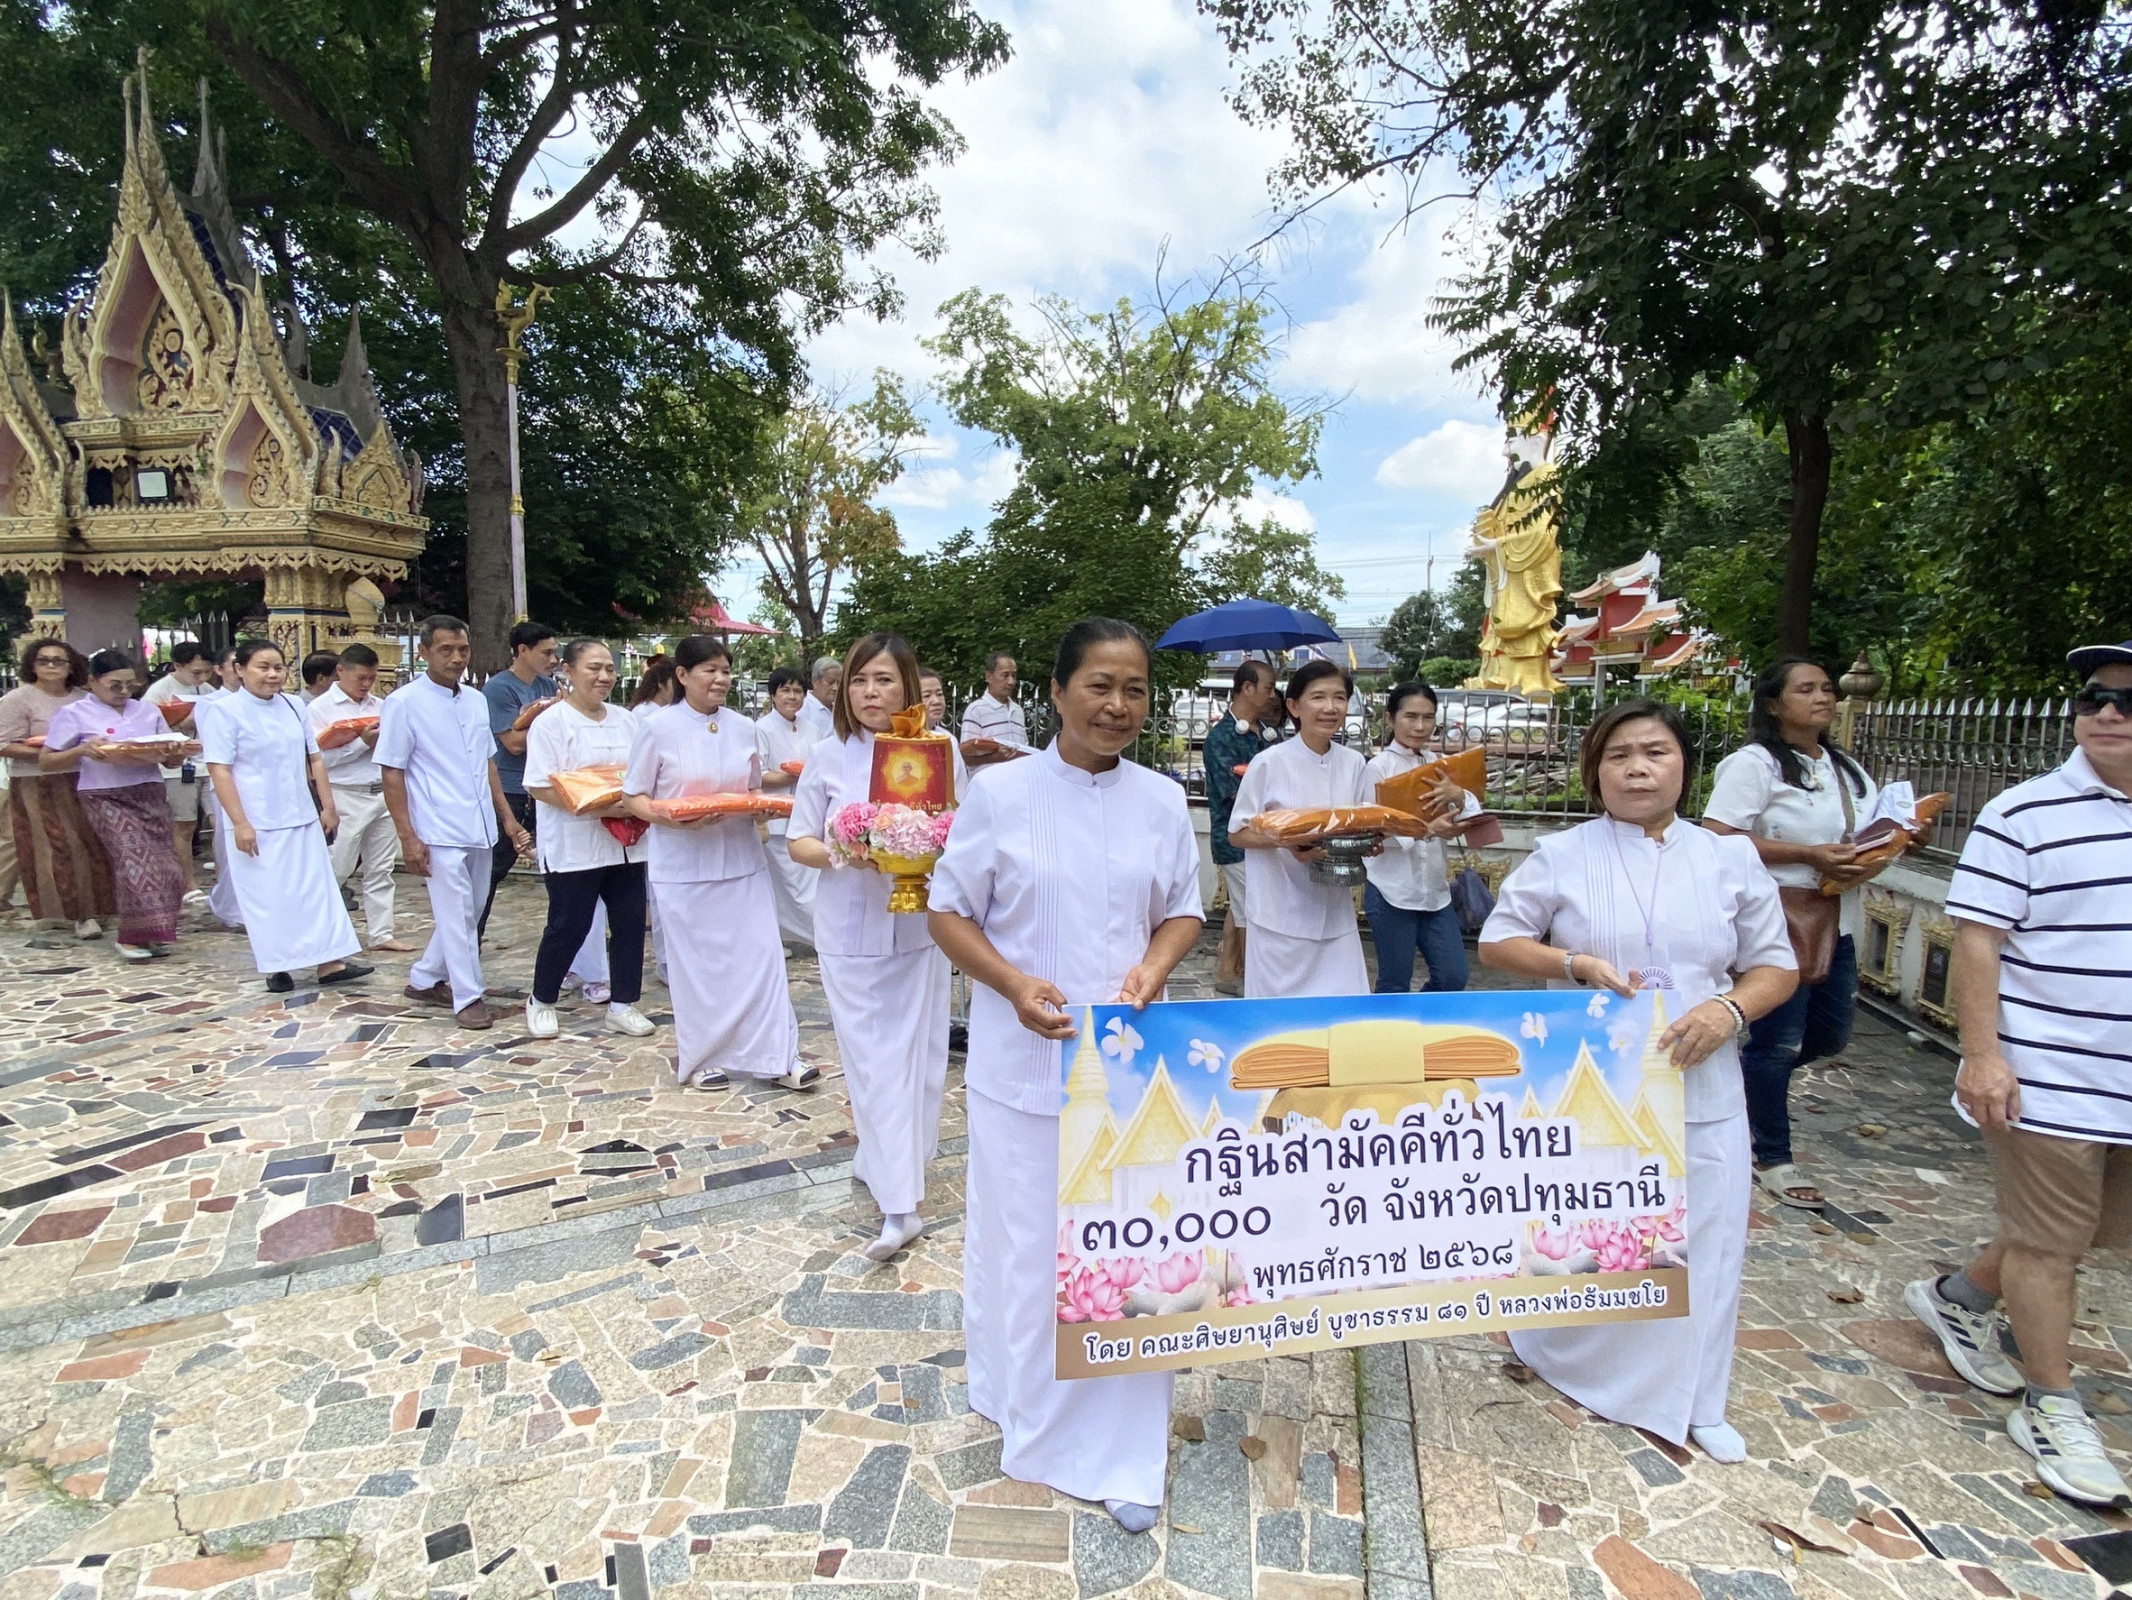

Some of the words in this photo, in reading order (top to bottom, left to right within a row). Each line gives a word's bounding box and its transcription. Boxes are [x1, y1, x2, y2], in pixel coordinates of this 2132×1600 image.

[1185, 1099, 1572, 1197] กฐินสามัคคีทั่วไทย
[1083, 1206, 1271, 1252] ๓๐,๐๐๐
[1320, 1181, 1367, 1227] วัด
[1383, 1163, 1666, 1226] จังหวัดปทุมธานี
[1253, 1246, 1407, 1298] พุทธศักราช
[1418, 1238, 1514, 1270] ๒๕๖๘
[1085, 1335, 1131, 1361] โดย
[1141, 1308, 1319, 1355] คณะศิษยานุศิษย์
[1328, 1304, 1429, 1340] บูชาธรรม
[1437, 1302, 1467, 1320] ๘๑
[1476, 1293, 1491, 1316] ปี
[1499, 1282, 1667, 1315] หลวงพ่อธัมมชโย
